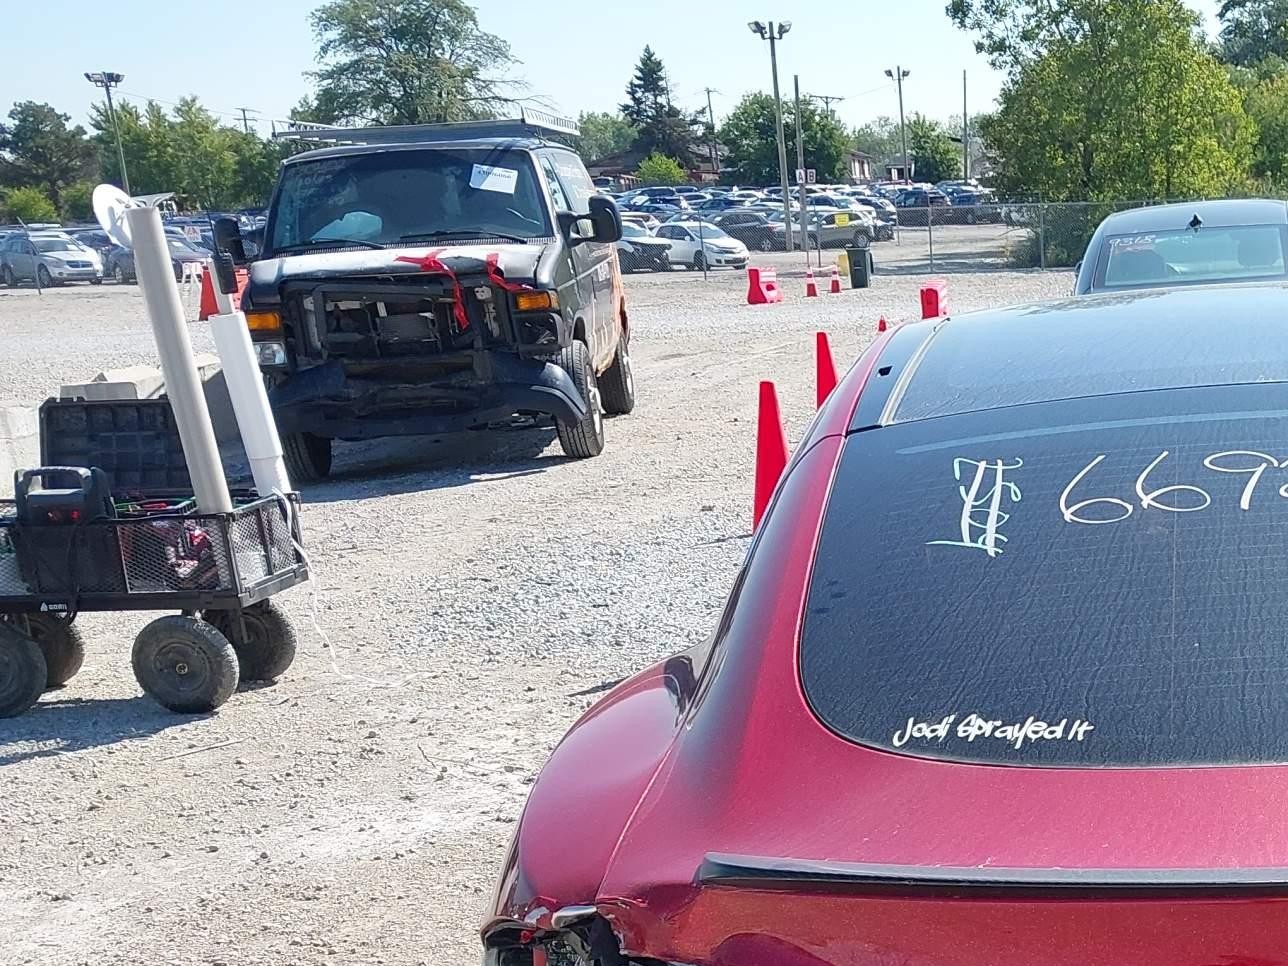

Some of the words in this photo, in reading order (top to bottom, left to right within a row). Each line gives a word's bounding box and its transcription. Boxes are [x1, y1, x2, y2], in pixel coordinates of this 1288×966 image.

[892, 712, 957, 747] Jodi
[956, 713, 1067, 749] Sprayed
[1067, 719, 1094, 741] It
